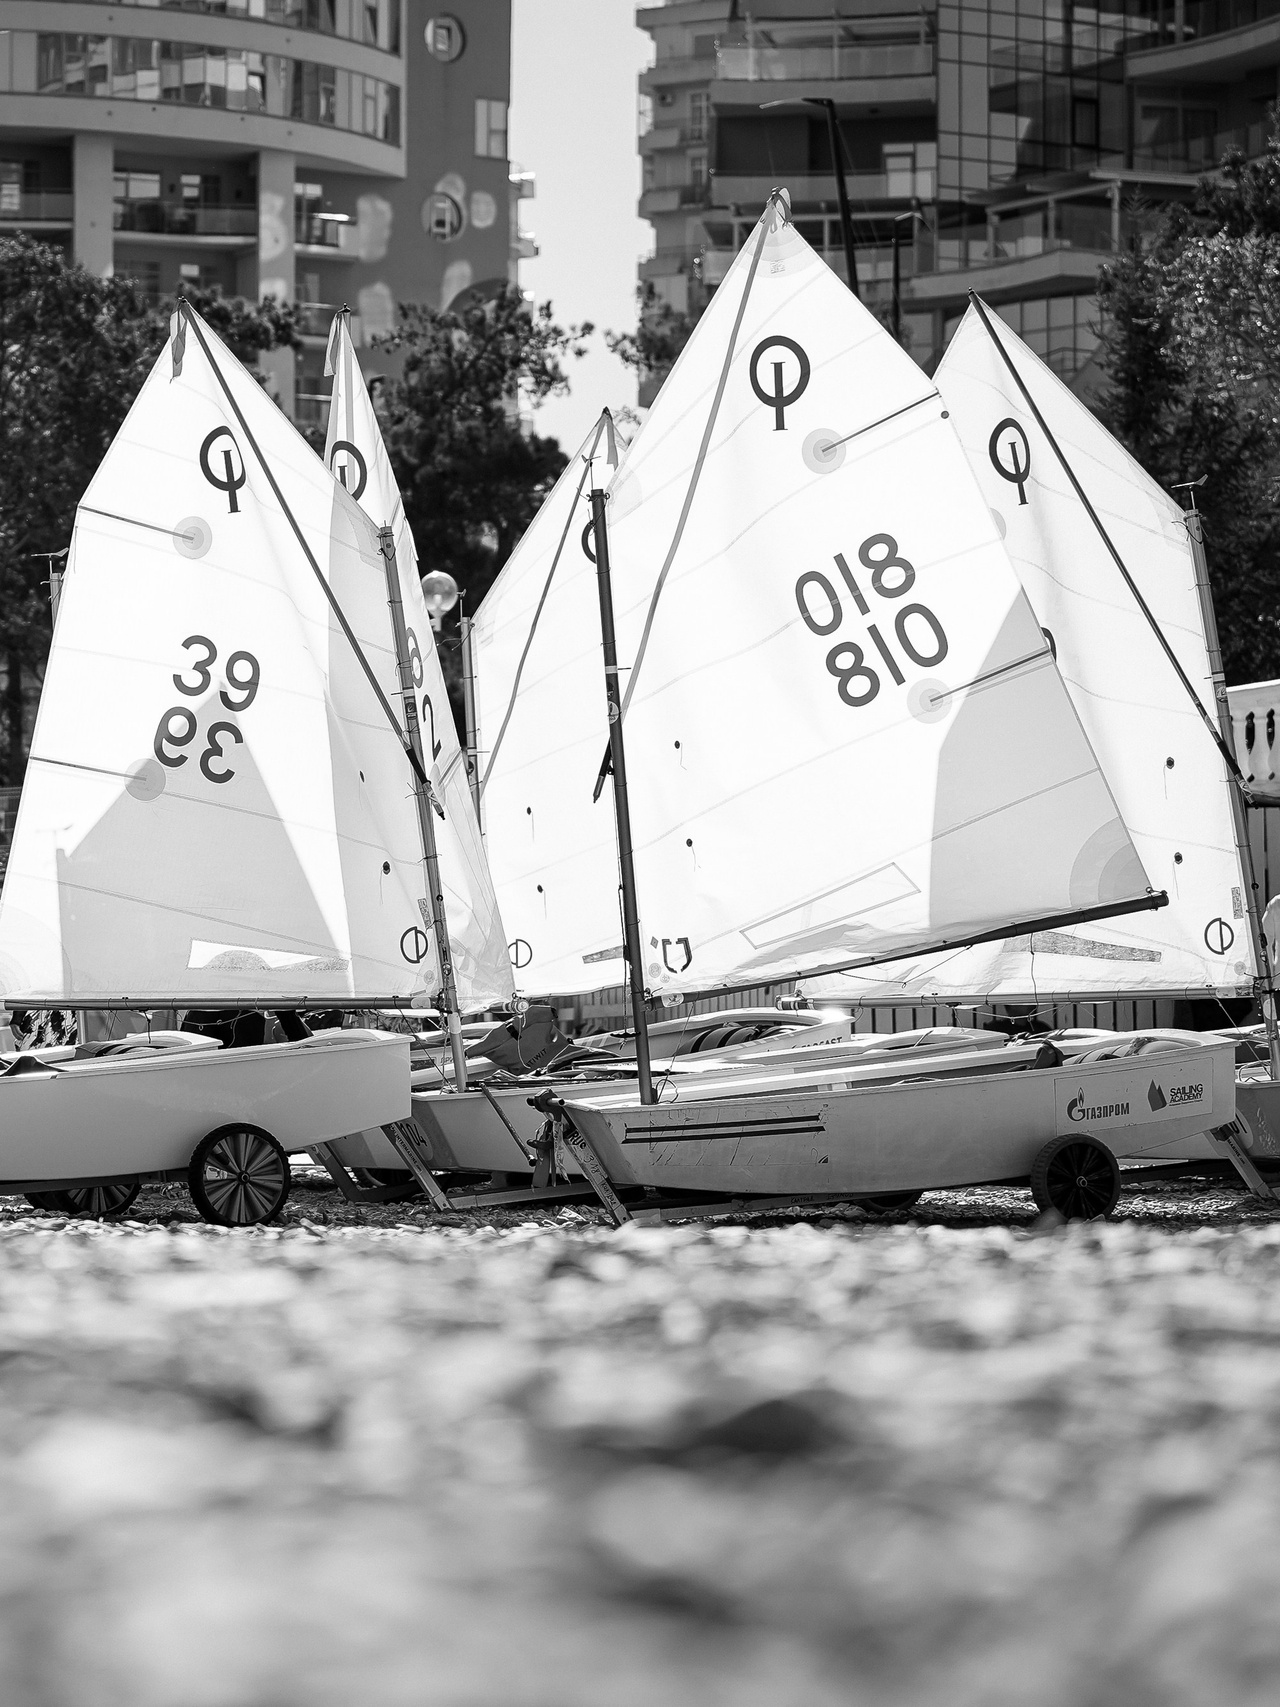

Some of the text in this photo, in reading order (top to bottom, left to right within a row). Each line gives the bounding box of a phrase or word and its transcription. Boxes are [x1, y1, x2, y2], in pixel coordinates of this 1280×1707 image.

[825, 603, 949, 707] 810
[172, 634, 261, 712] 39
[1170, 1083, 1203, 1097] SAILING
[1170, 1092, 1203, 1104] ACADEMY
[1086, 1102, 1130, 1120] ГАЗПРОМ
